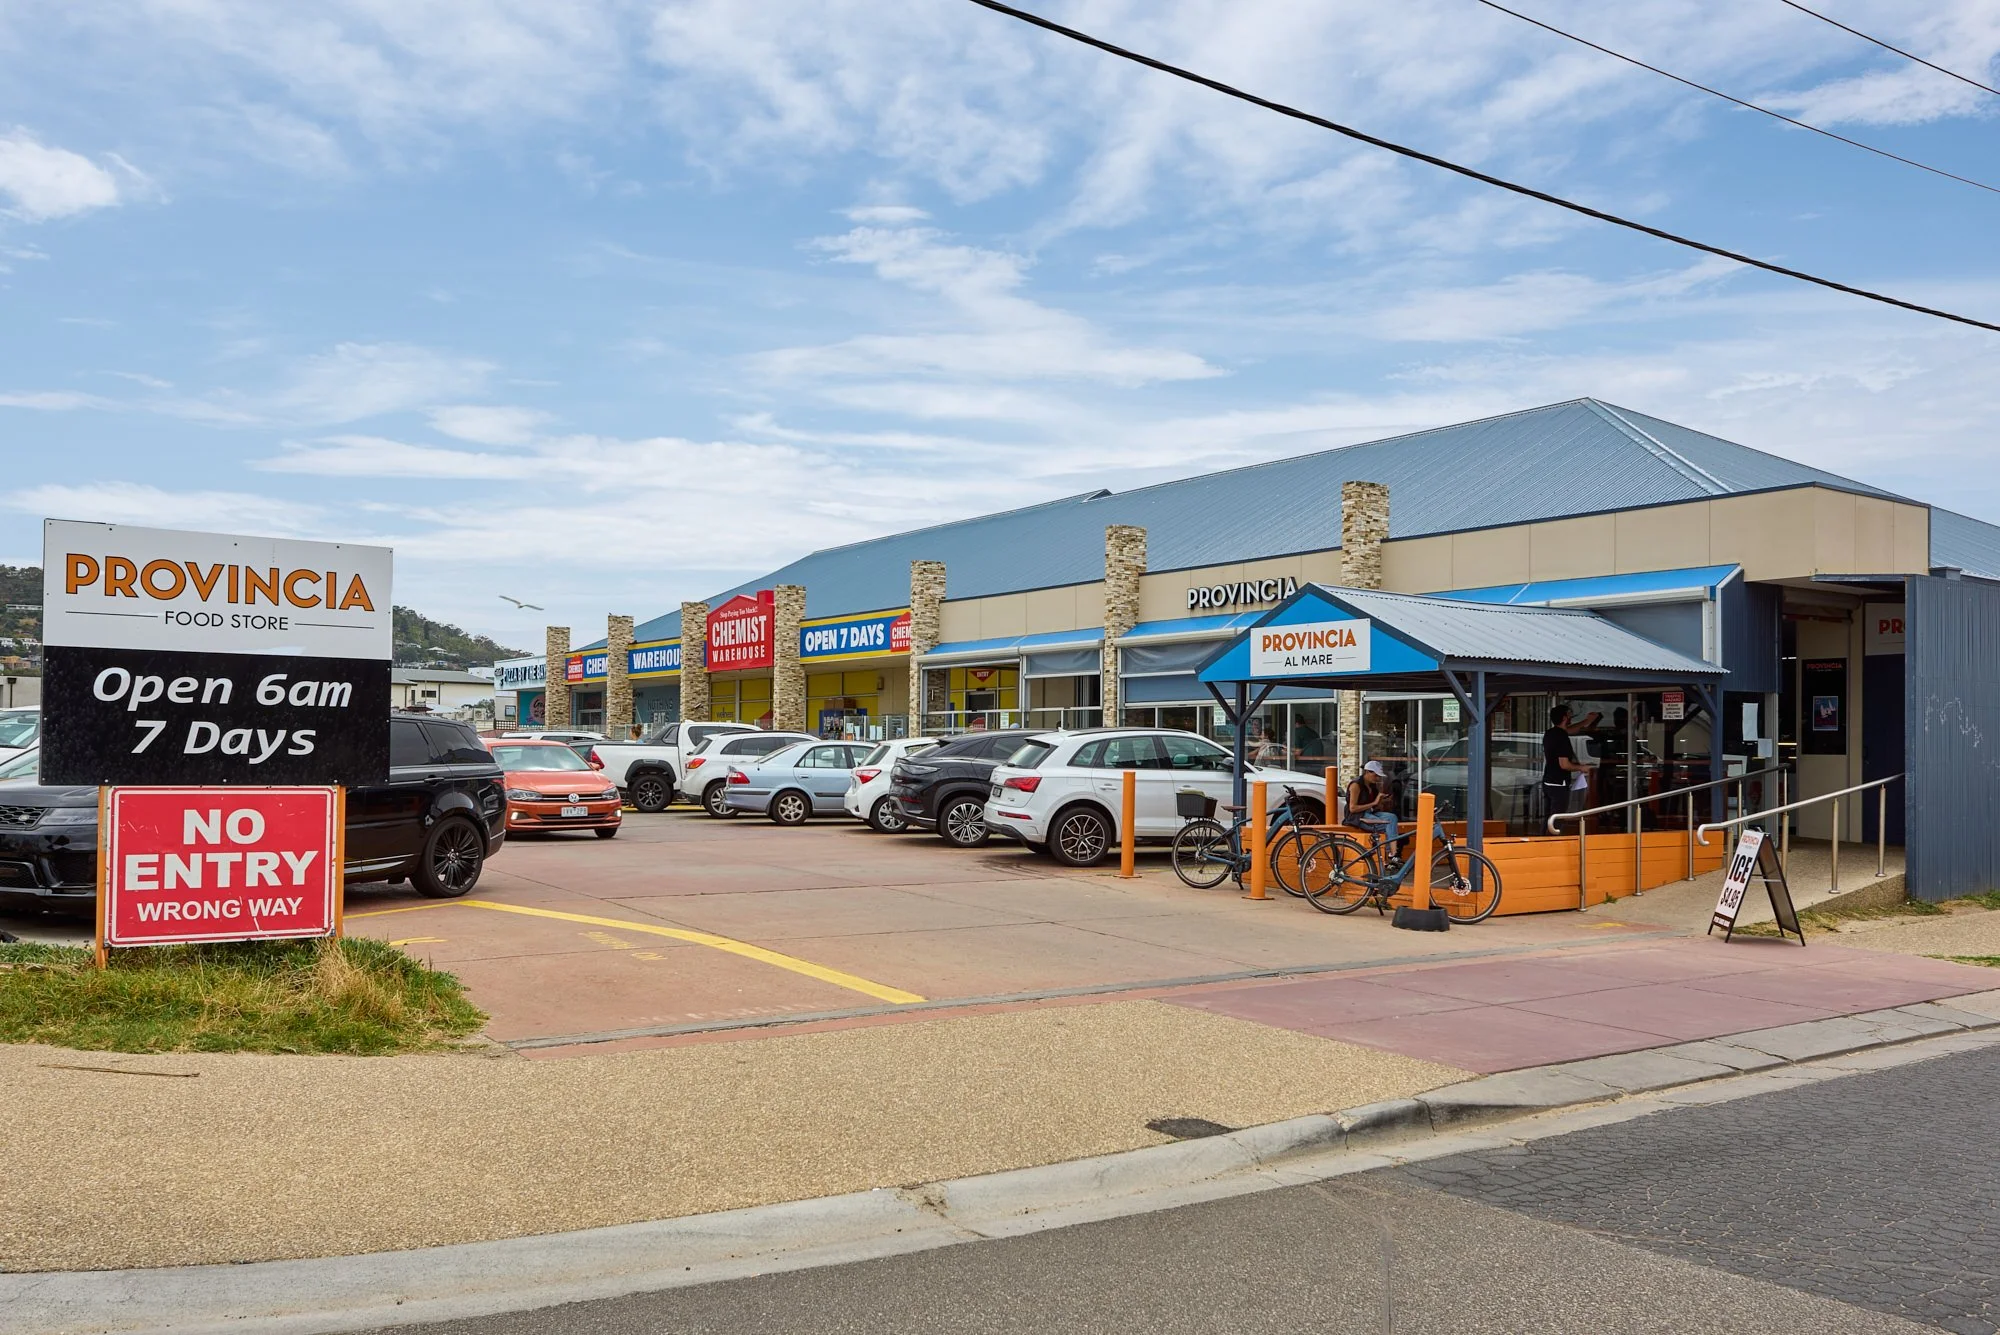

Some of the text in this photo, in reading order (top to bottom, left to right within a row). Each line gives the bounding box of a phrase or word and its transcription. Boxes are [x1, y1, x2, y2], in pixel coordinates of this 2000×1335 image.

[65, 553, 375, 612] PROVINCIA
[1187, 576, 1298, 609] PROVINCIA
[164, 610, 289, 631] FOOD STORE
[712, 615, 767, 647] CHEMIST
[1879, 618, 1905, 634] PR
[805, 623, 884, 652] OPEN 7 DAYS
[1262, 628, 1357, 652] PROVINCIA
[712, 645, 765, 662] WAREHOUSE
[1284, 654, 1333, 667] AL MARE
[93, 667, 353, 711] Open 6am
[131, 720, 317, 764] 7 Days
[183, 808, 265, 845] NO
[124, 850, 318, 892] ENTRY
[1728, 854, 1753, 884] ICE
[136, 897, 304, 922] WRONG WAY
